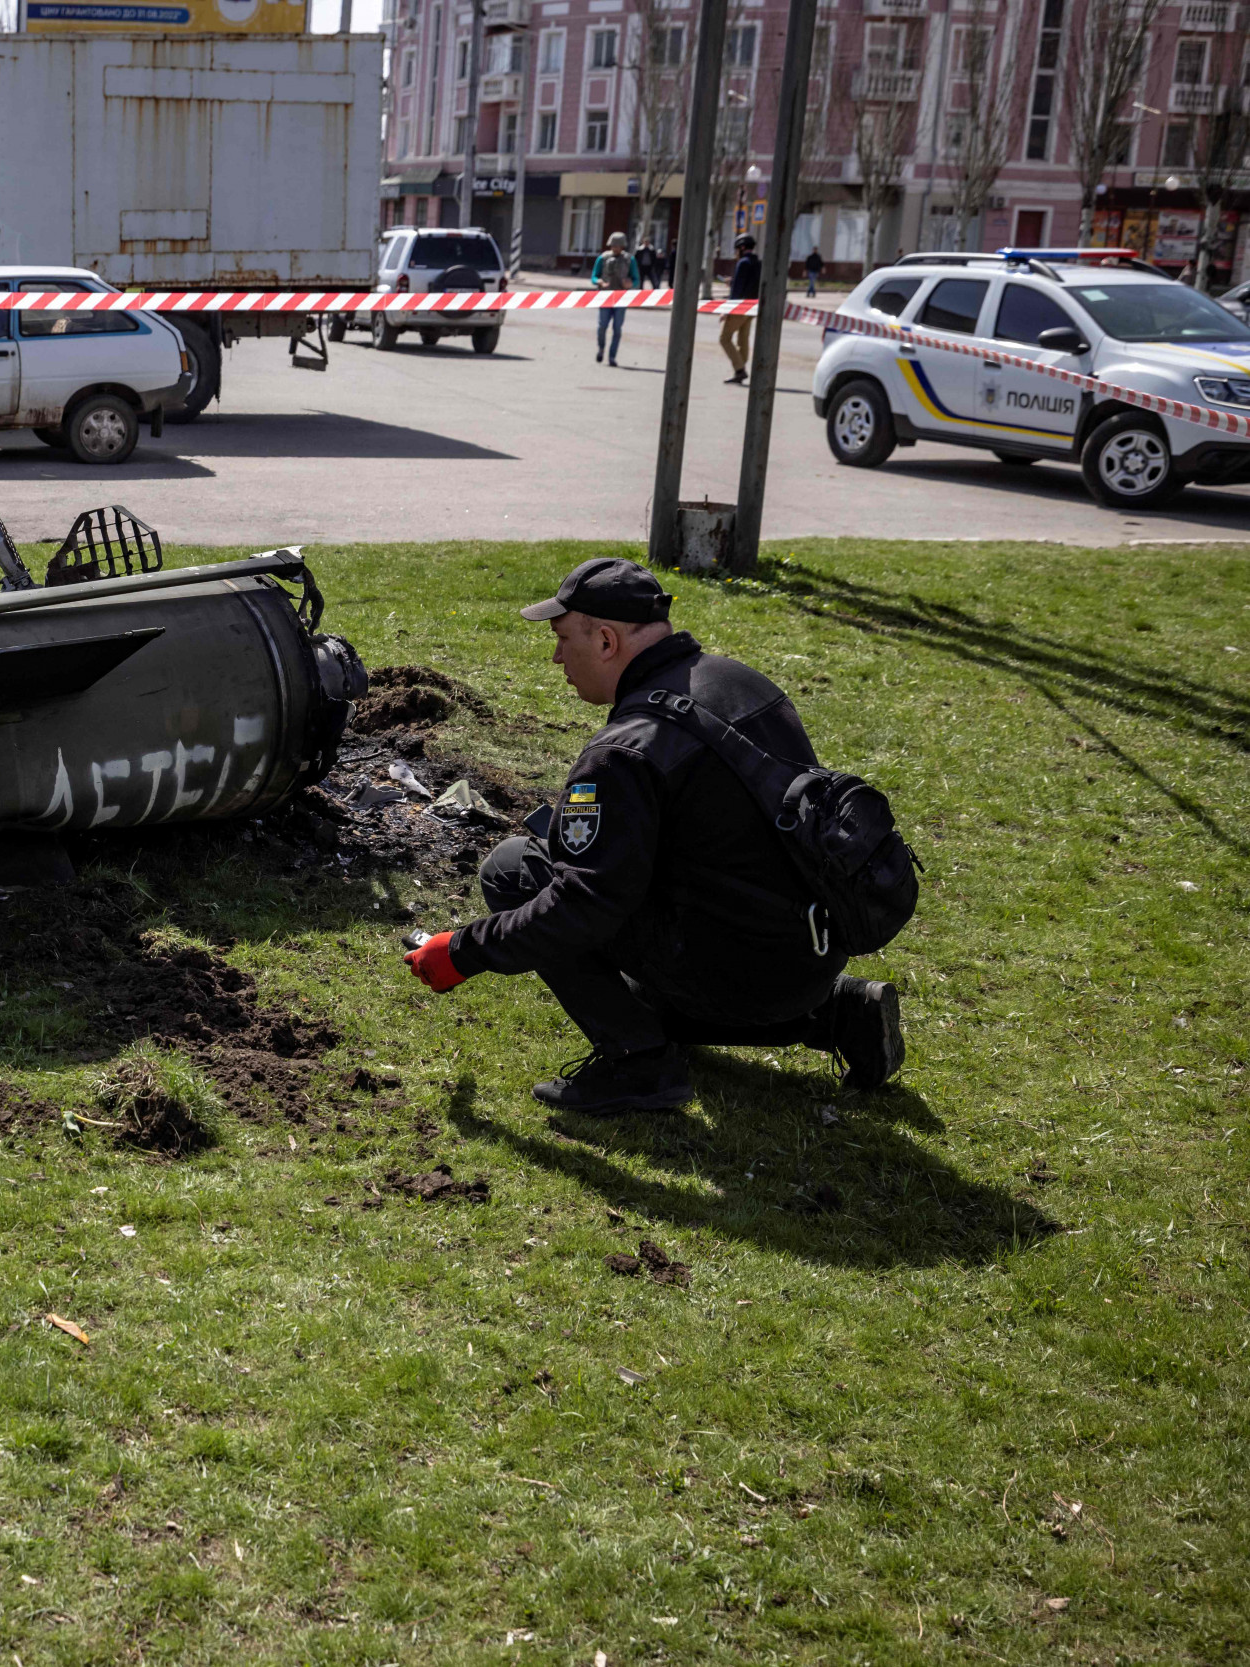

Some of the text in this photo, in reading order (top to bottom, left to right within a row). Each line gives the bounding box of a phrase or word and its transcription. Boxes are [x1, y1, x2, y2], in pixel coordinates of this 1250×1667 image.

[490, 177, 517, 193] City
[1006, 391, 1075, 415] ПОЛІЦІЯ
[564, 806, 597, 814] ПОЛІЦІЯ
